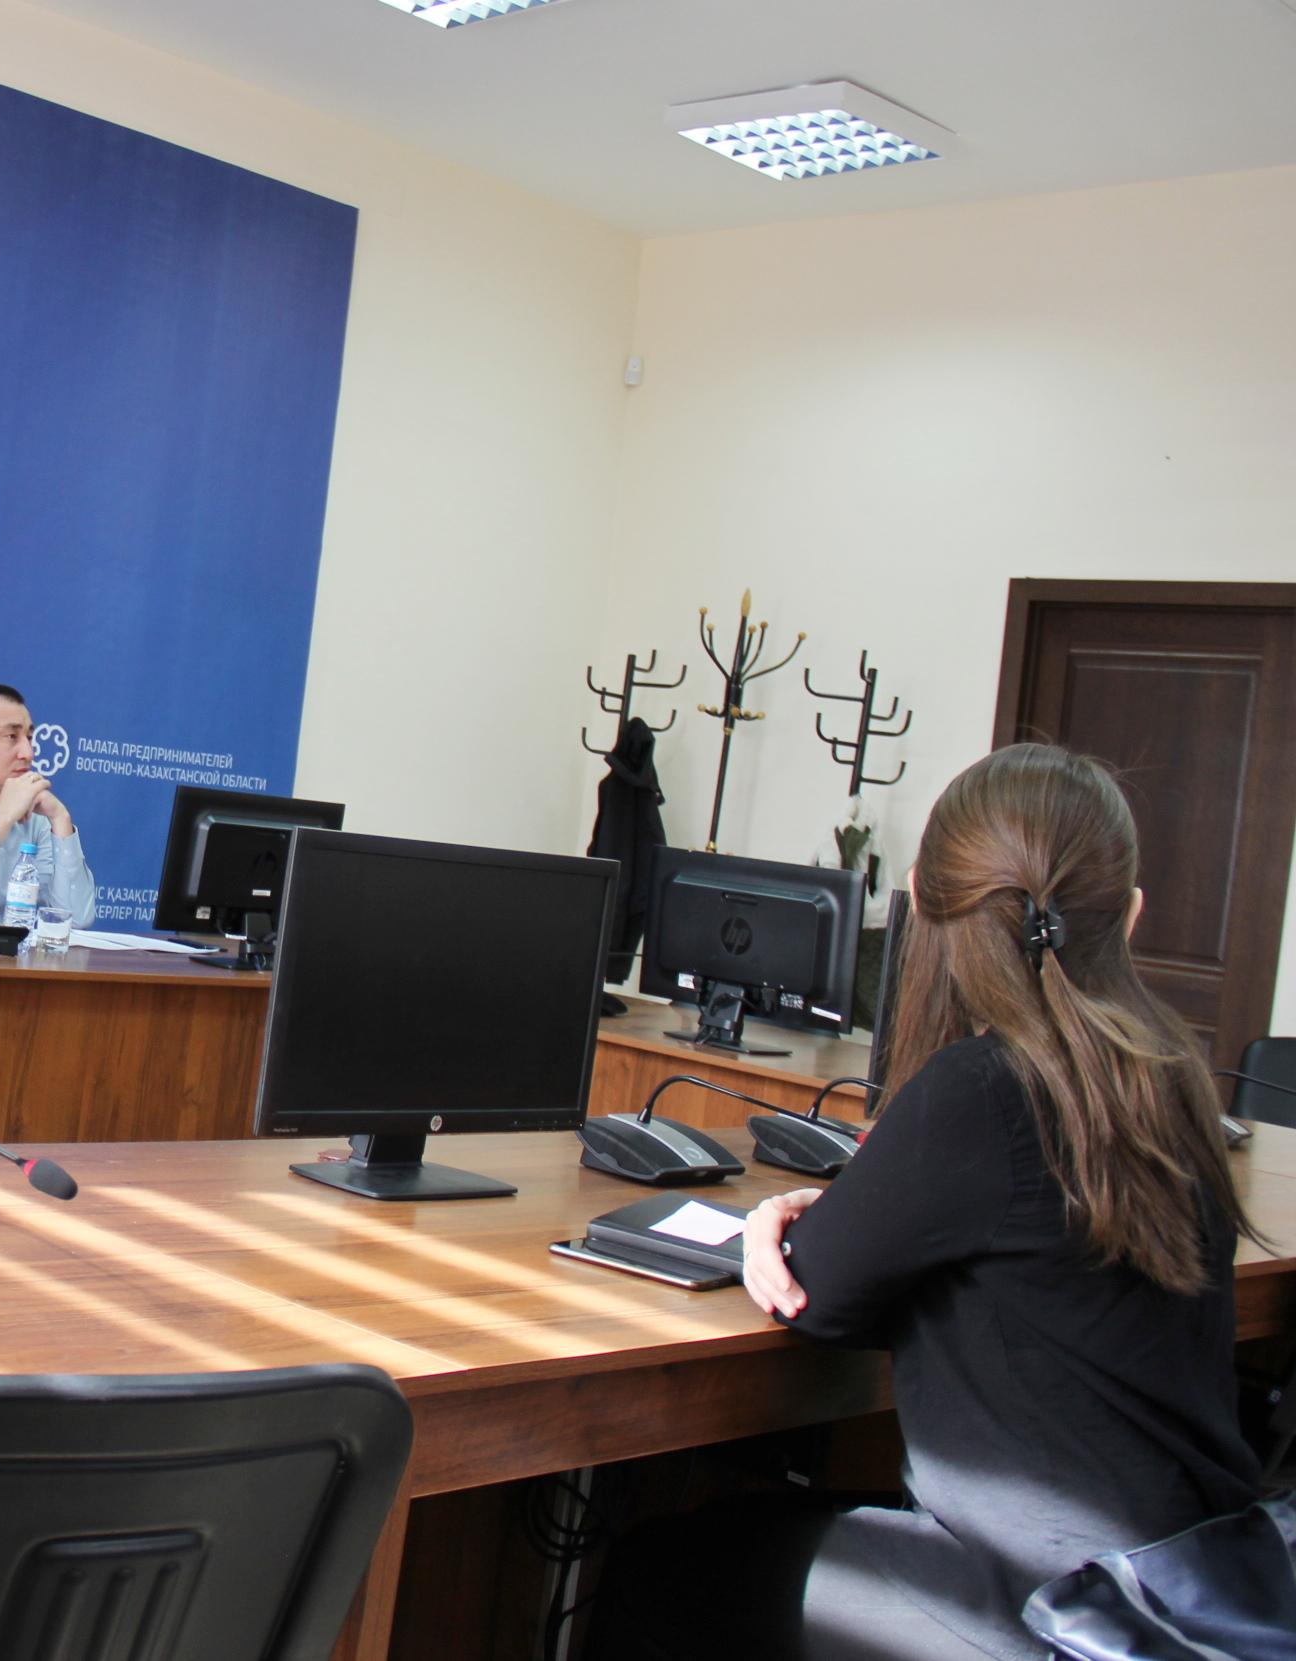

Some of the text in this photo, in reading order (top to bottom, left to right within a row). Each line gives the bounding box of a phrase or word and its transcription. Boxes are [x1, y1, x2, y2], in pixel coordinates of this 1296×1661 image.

[78, 737, 234, 770] ПАЛАТА ПРЕДПРИНИМАТЕЛЕЙ
[76, 757, 267, 791] ВОСТОЧНО-КАЗАХСТАНСКОЙ ОБЛАСТИ
[107, 887, 159, 904] ҚАЗАҚСТА
